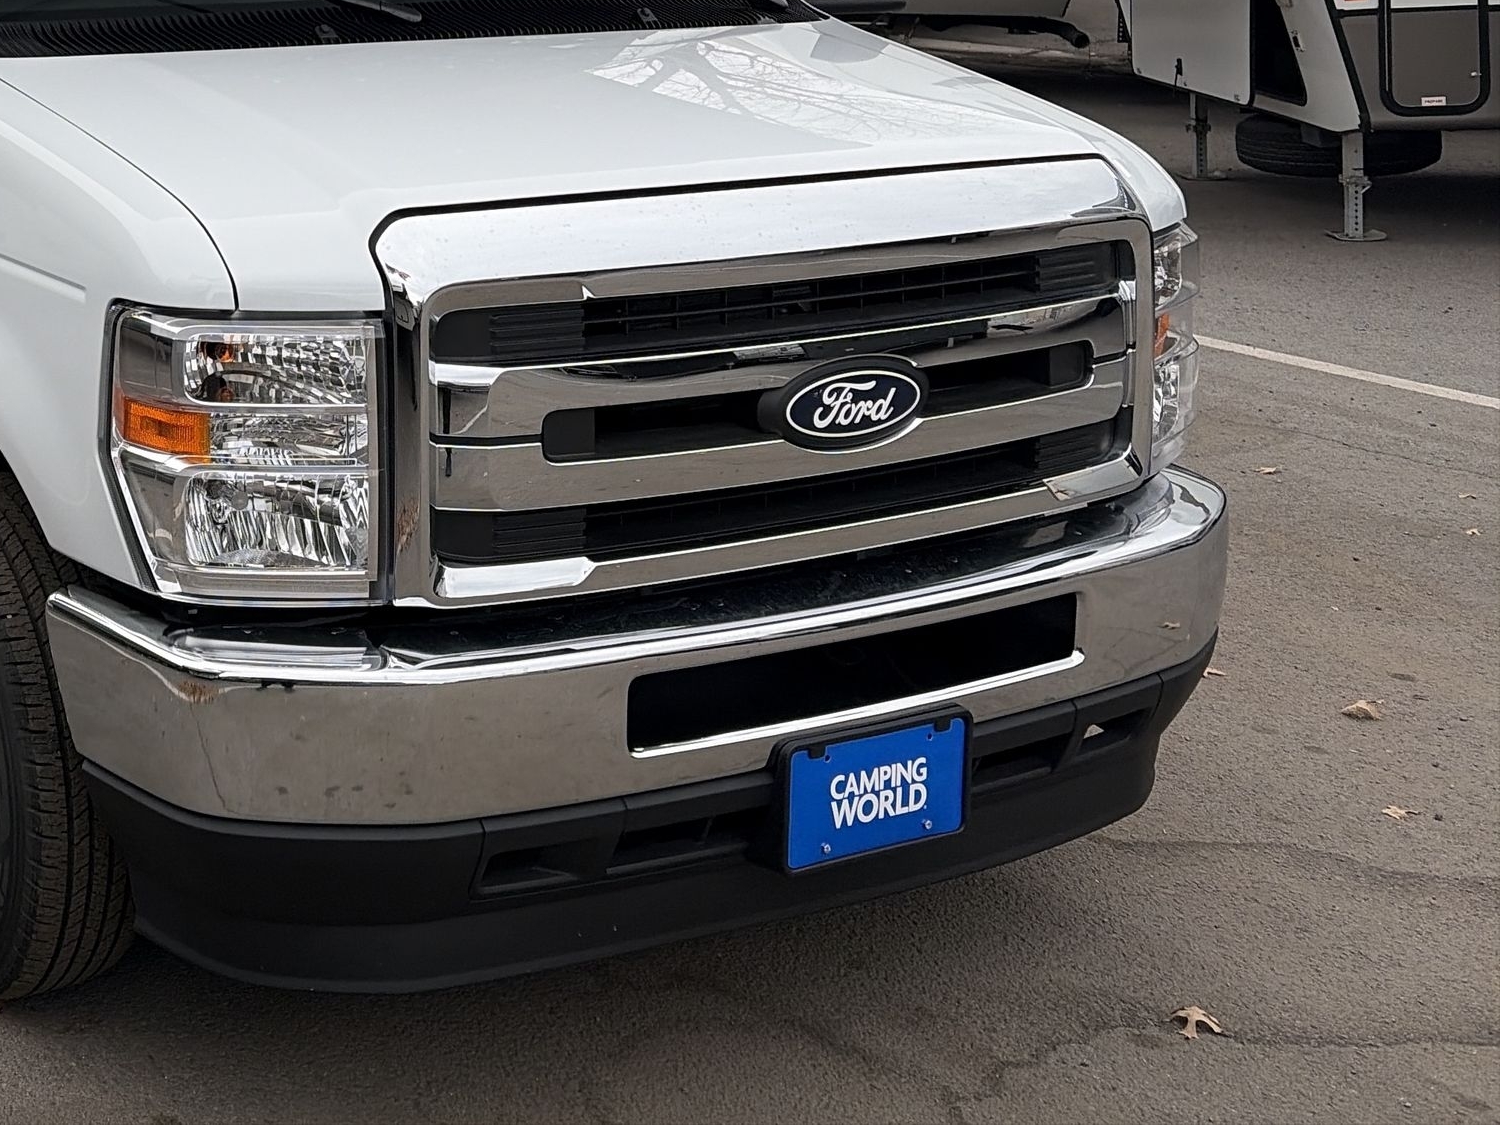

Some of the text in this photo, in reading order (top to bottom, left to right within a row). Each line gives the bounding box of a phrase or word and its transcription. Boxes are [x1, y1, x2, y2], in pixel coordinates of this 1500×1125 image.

[813, 380, 897, 429] Ford
[830, 757, 928, 800] CAMPING
[831, 783, 927, 829] WORLD
